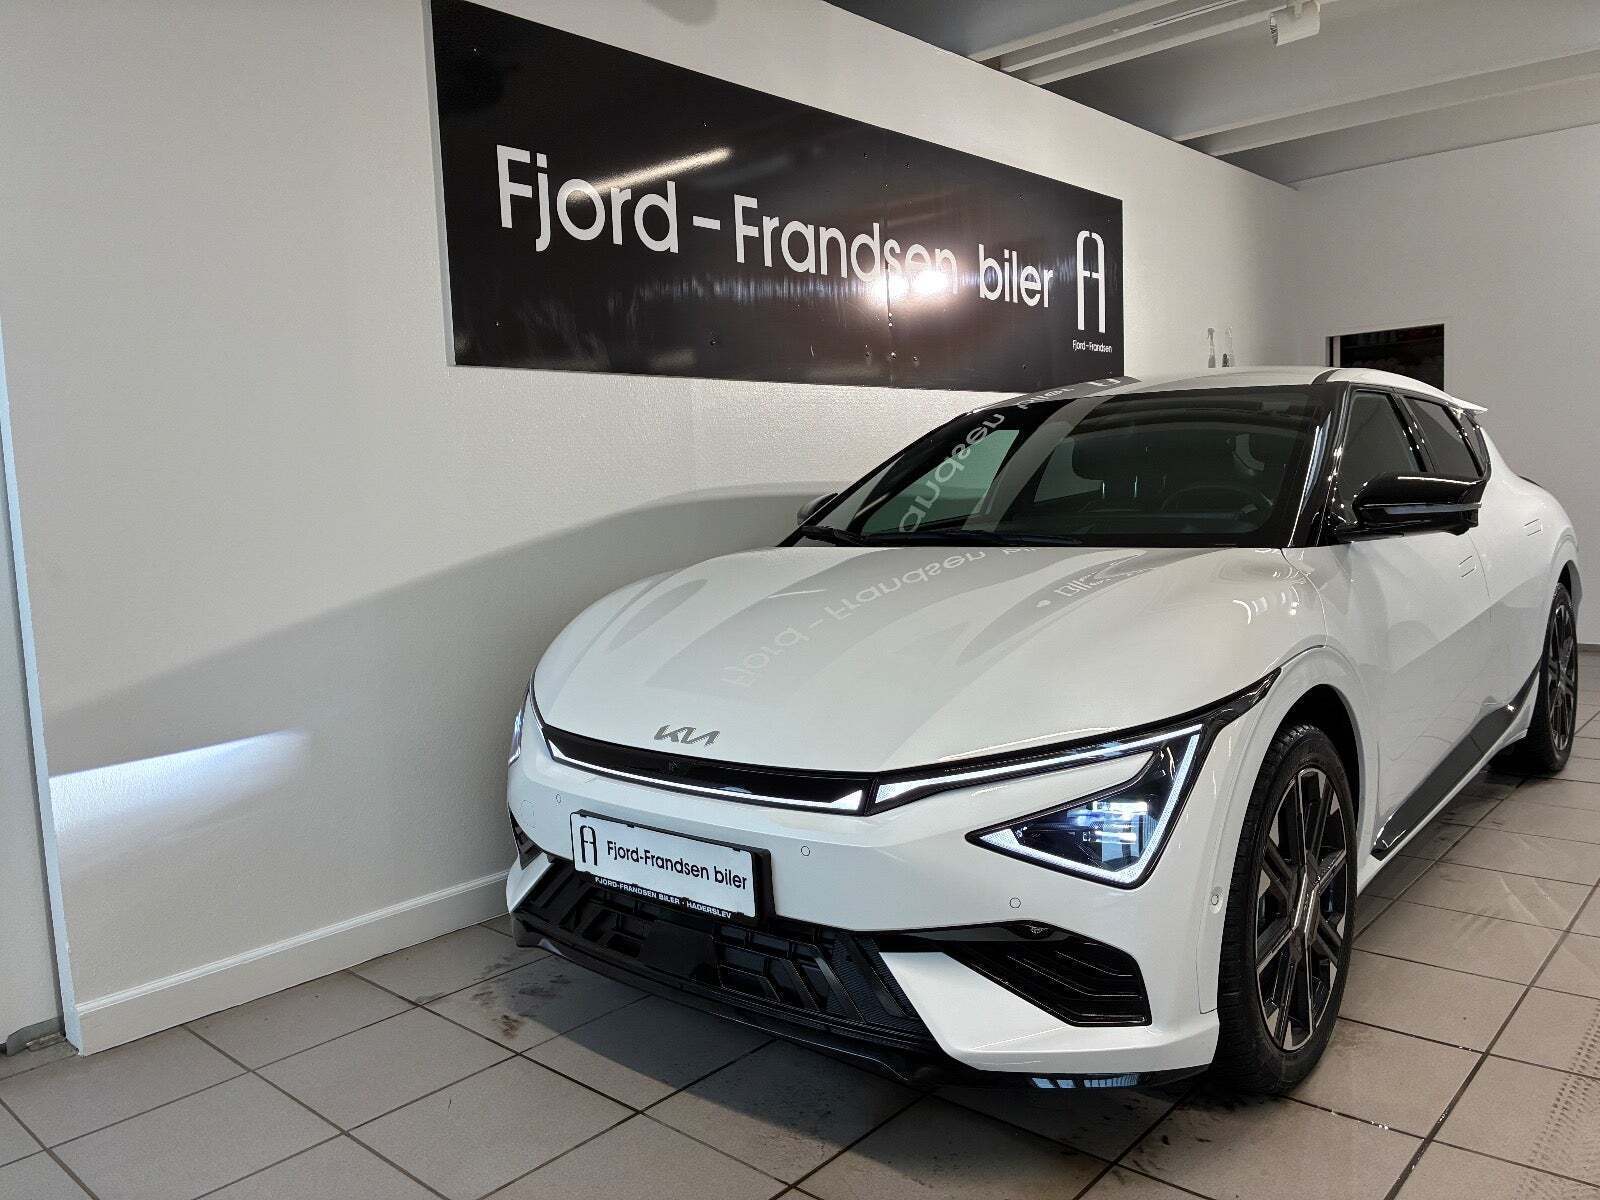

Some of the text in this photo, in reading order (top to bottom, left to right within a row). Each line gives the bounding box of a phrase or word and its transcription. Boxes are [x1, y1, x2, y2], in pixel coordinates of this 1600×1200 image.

[497, 144, 678, 254] Fjord
[978, 243, 1053, 308] biler
[654, 724, 721, 747] KIA
[607, 841, 747, 890] Fjord-Frandsen biler
[595, 877, 732, 920] FJORD-FRANDSEN BILER HADERSLEV
